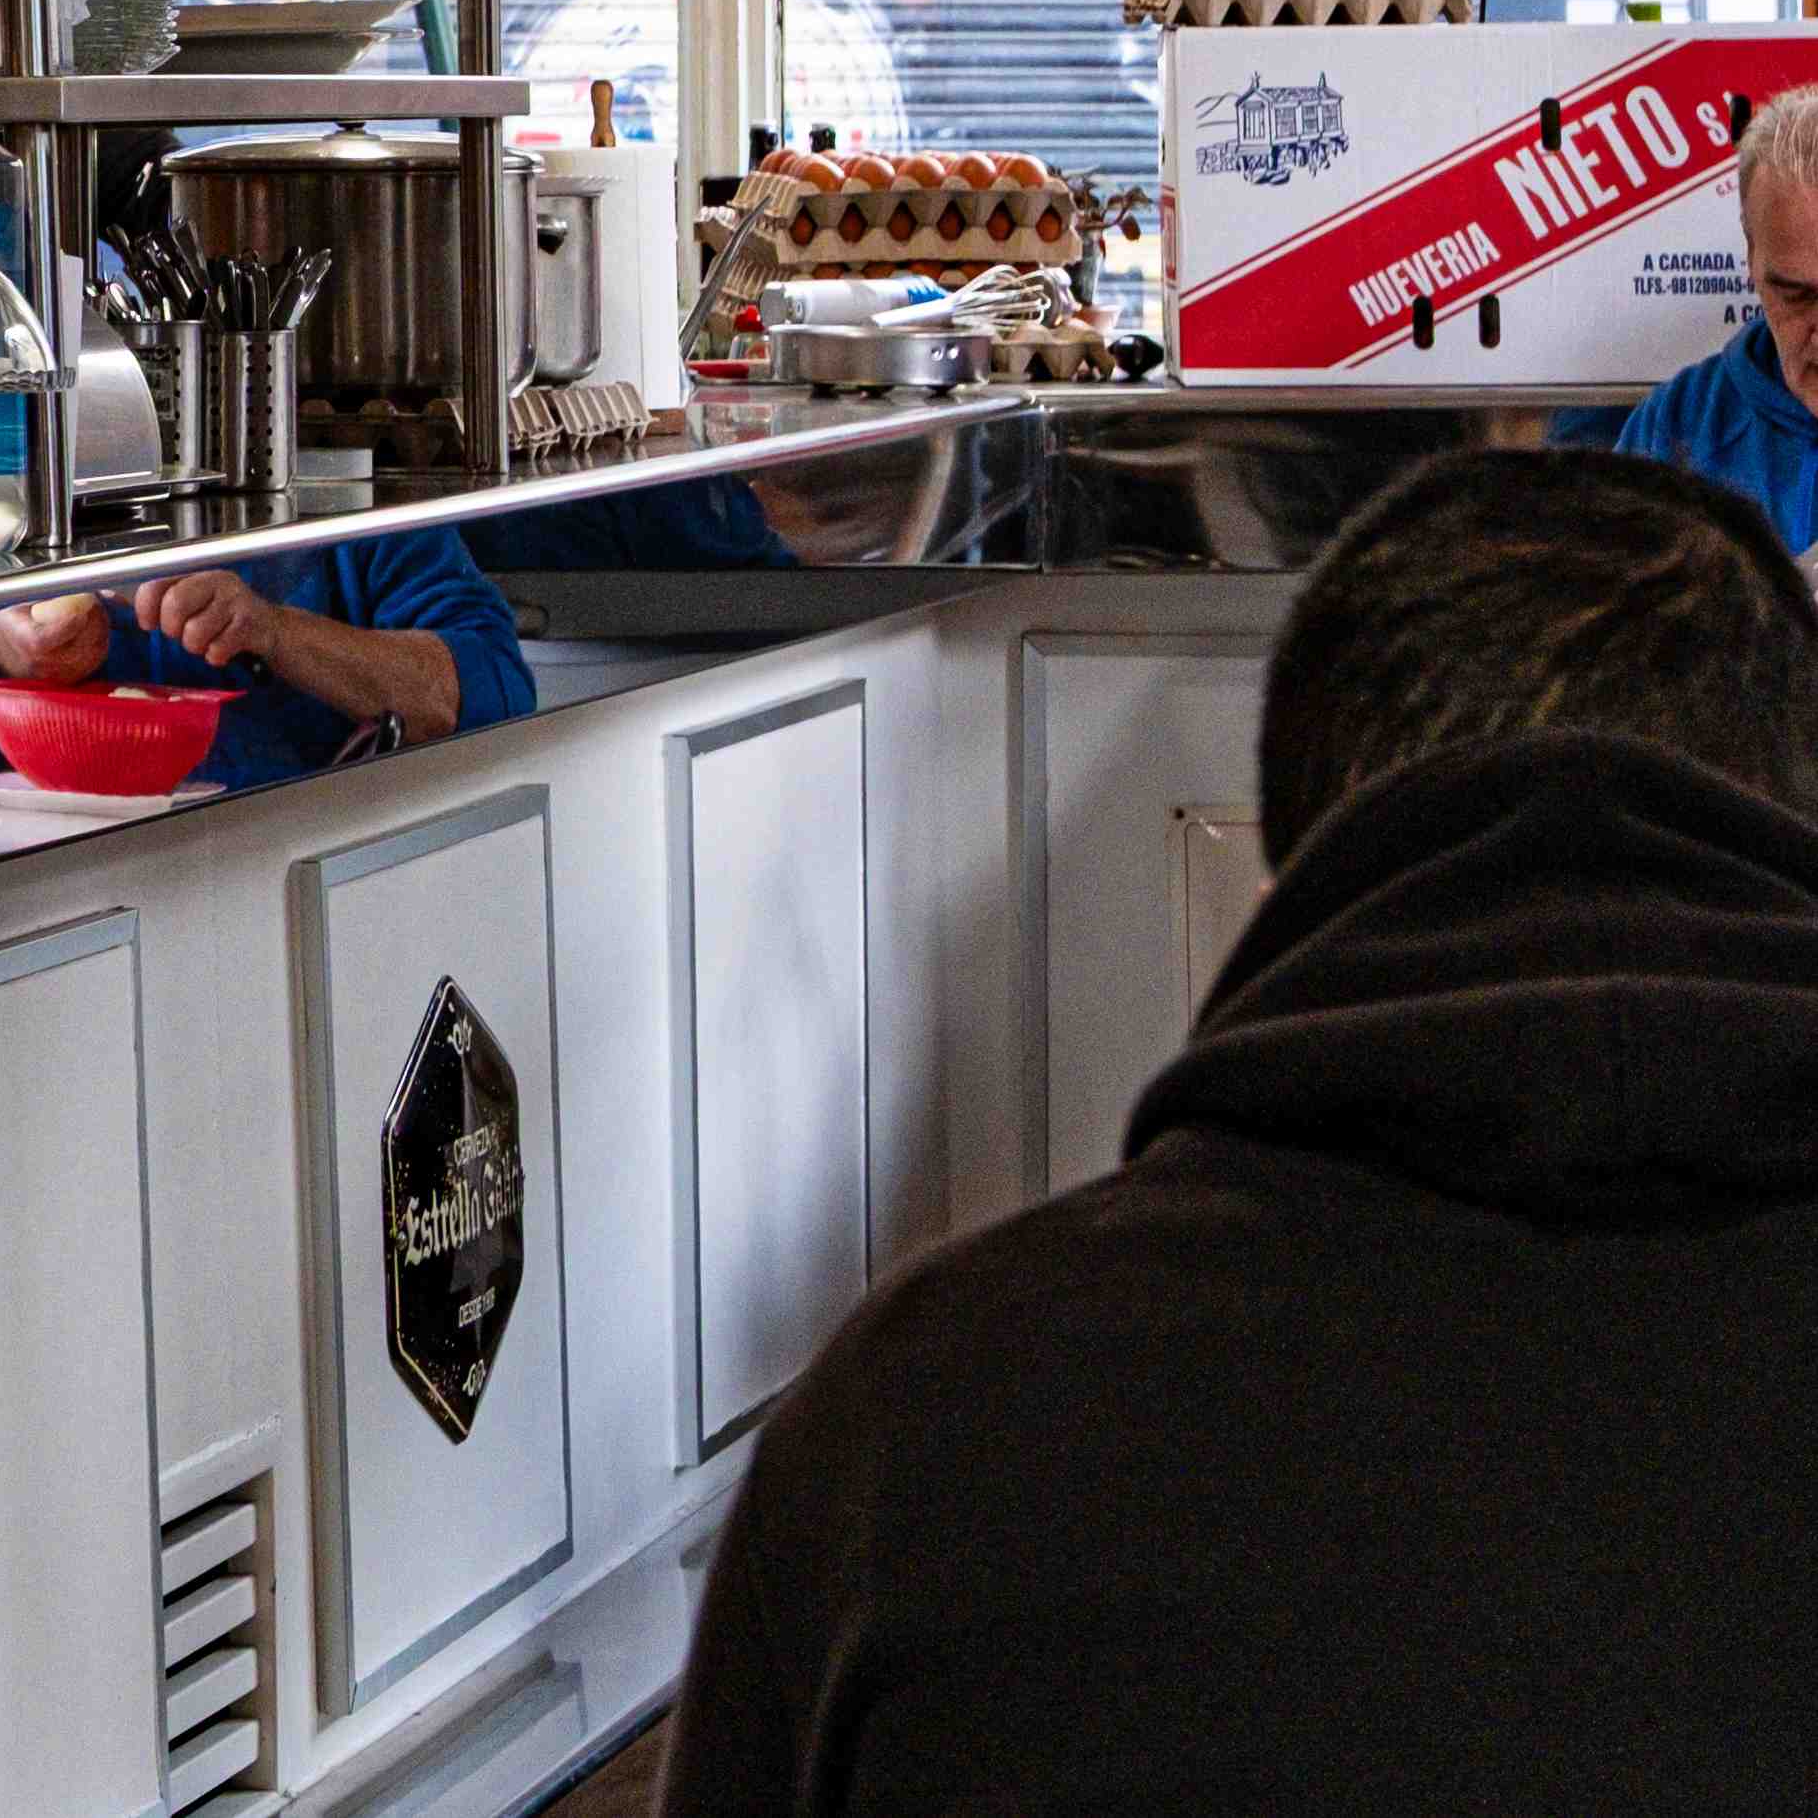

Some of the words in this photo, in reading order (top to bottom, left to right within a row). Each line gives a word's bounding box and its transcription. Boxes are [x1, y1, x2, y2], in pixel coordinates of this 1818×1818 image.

[1348, 222, 1500, 327] HUEVERIA
[1493, 85, 1690, 242] NIETO
[1643, 254, 1654, 272] A
[1659, 253, 1735, 271] CACHADA
[1724, 304, 1736, 325] A
[404, 1179, 481, 1267] Estrella
